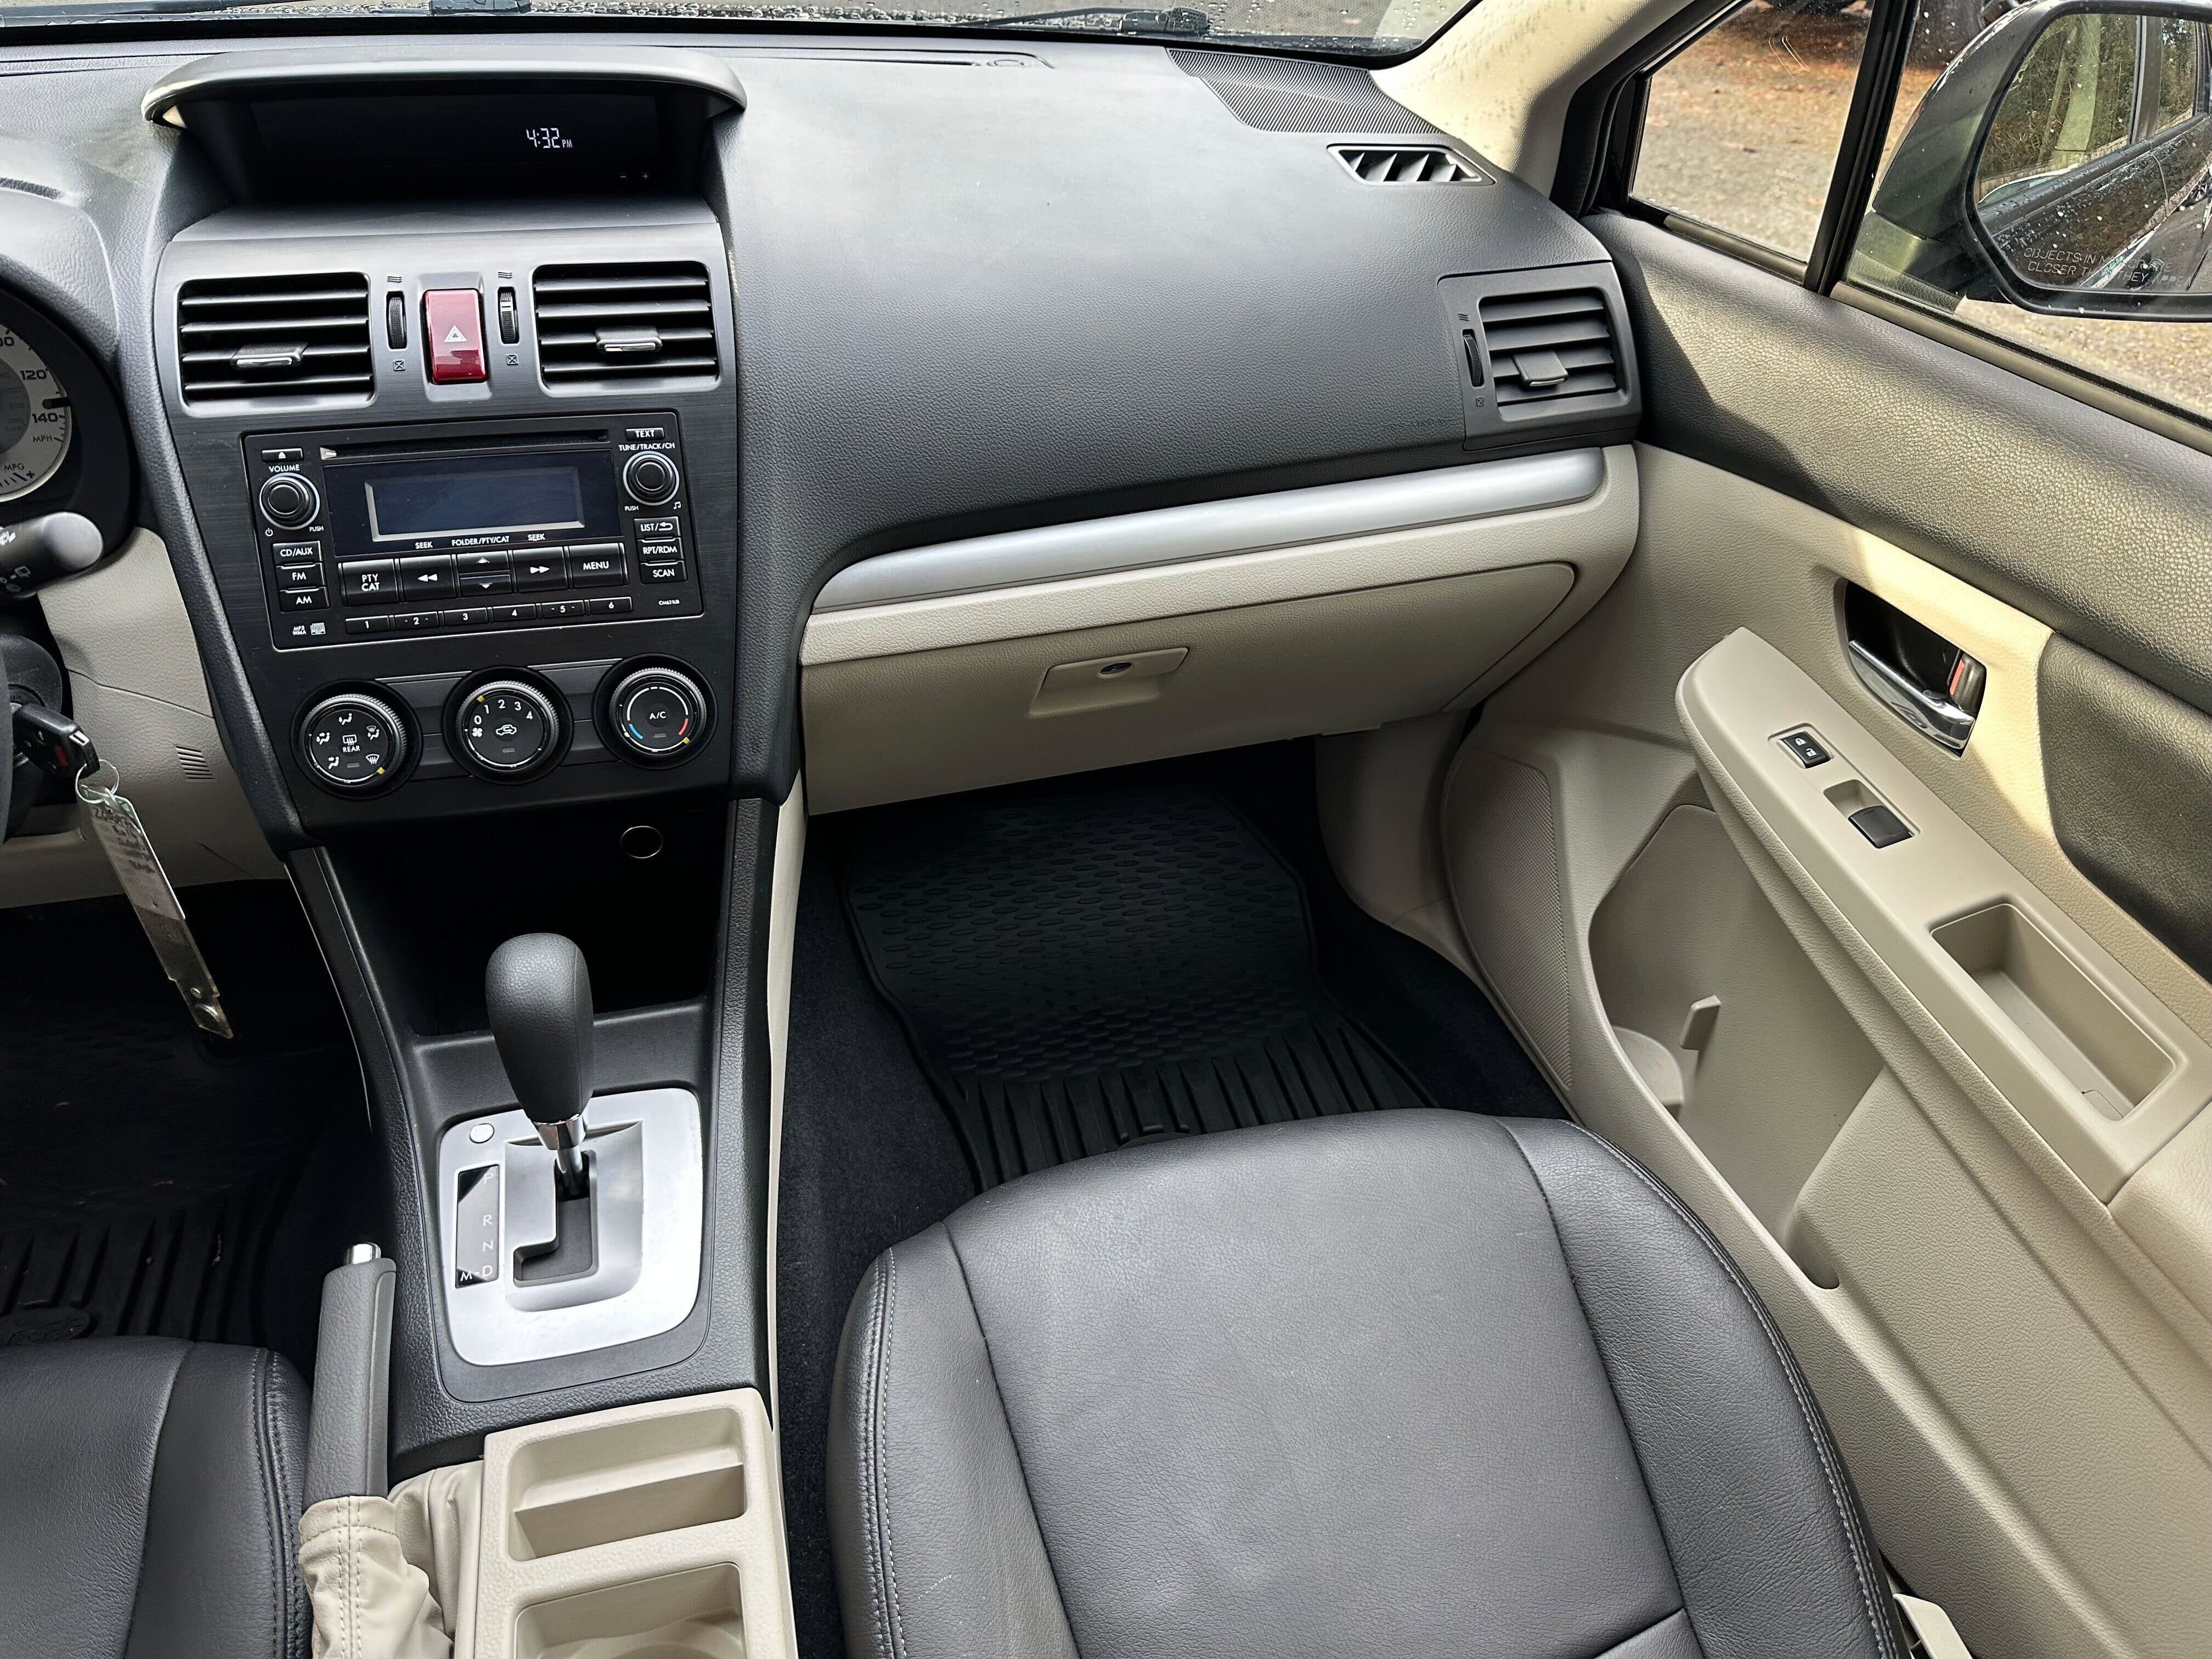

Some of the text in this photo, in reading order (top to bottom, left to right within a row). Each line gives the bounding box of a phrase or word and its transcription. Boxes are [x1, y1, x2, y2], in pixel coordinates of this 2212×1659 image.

[526, 128, 573, 148] 4:32 PM
[2024, 248, 2080, 262] OBJECTS
[2083, 254, 2096, 264] IN
[2028, 261, 2076, 275] CLOSER
[2118, 270, 2149, 282] THEY
[20, 369, 47, 380] 120
[32, 412, 58, 423] 140
[33, 435, 52, 443] MPH
[618, 443, 675, 451] TUNE/TRACK/CH
[4, 462, 25, 472] MPG
[269, 464, 300, 472] VOLUME
[452, 535, 510, 546] FOLDER/PTY/CAT
[527, 533, 545, 541] SEEK
[415, 541, 433, 549] SEEK
[280, 547, 313, 557] CD/AUX
[643, 546, 678, 555] RPT/RDM
[583, 561, 610, 571] MENU
[292, 572, 307, 580] FM
[362, 573, 378, 582] PTY
[653, 569, 675, 578] SCAN
[361, 582, 380, 591] CAT
[296, 596, 312, 605] AM
[365, 620, 369, 629] 1
[413, 617, 420, 625] 2
[484, 704, 489, 714] 1
[498, 699, 506, 709] 2
[514, 702, 521, 710] 3
[474, 715, 482, 725] 0
[526, 710, 533, 720] 4
[649, 711, 667, 720] A/C
[484, 1173, 494, 1185] P
[483, 1214, 492, 1226] R
[483, 1239, 493, 1252] N
